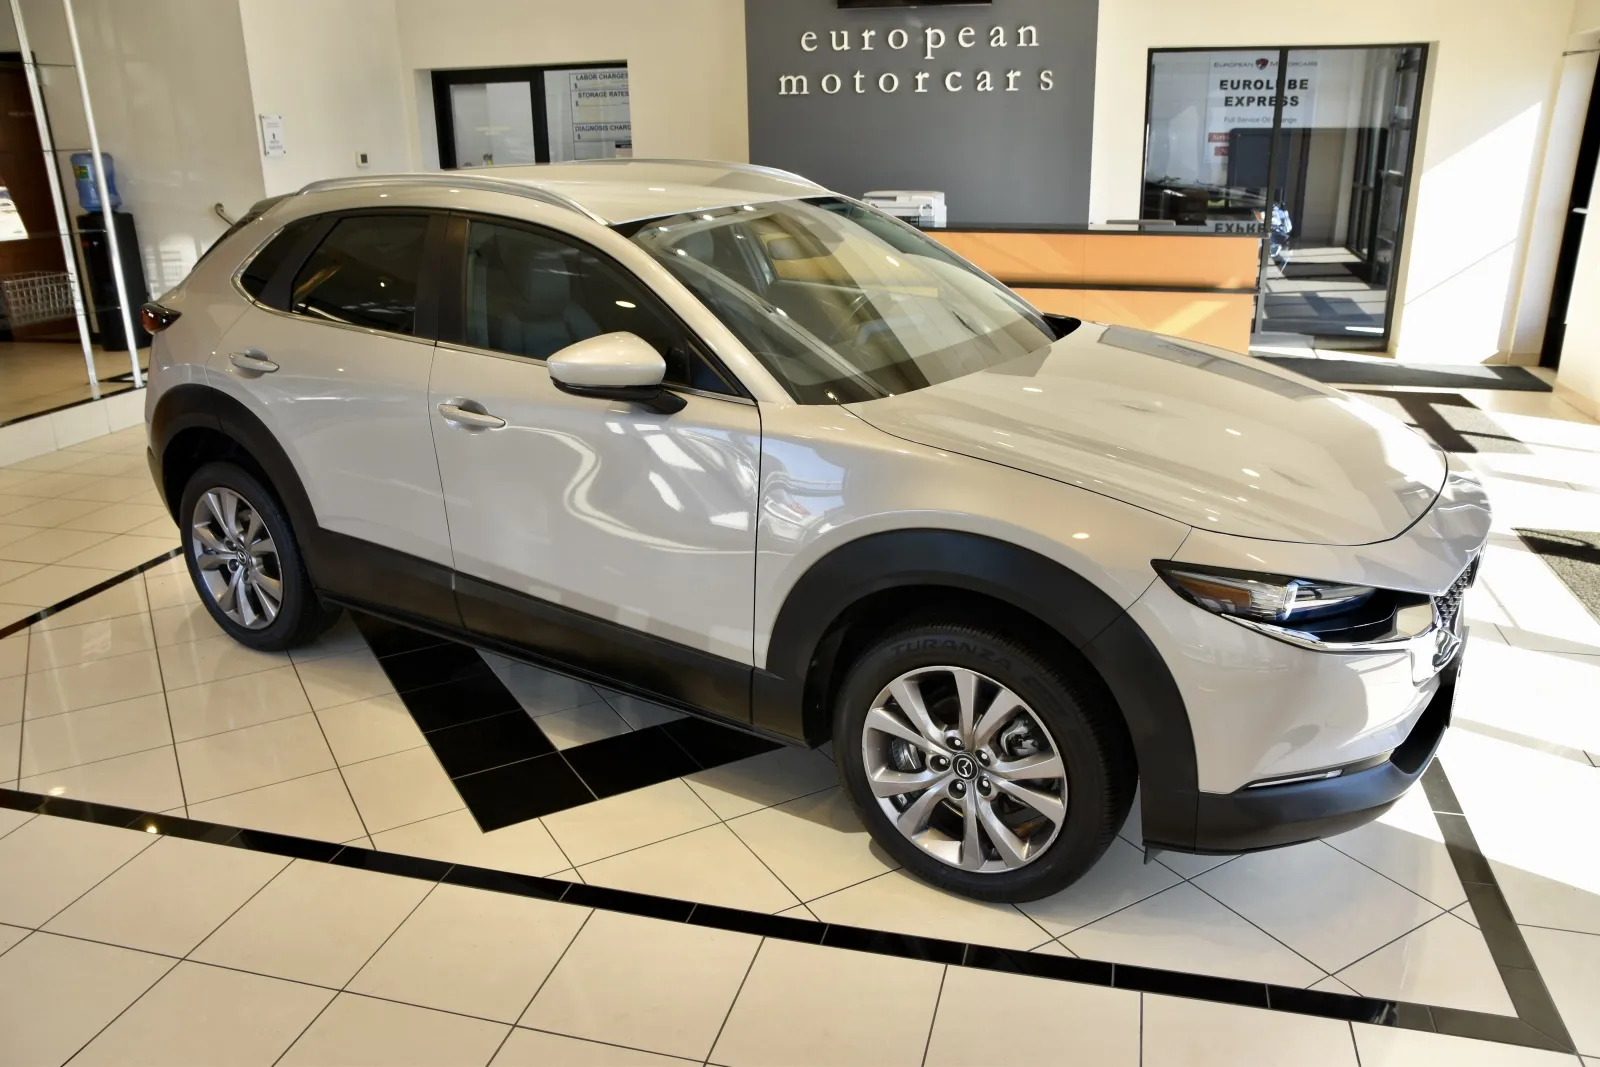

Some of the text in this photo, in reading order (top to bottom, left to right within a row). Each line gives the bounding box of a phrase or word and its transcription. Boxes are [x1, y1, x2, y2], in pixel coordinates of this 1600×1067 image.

[800, 24, 1039, 60] european
[578, 91, 608, 99] STORAGE
[778, 69, 1054, 95] motorcars
[1219, 79, 1309, 90] EUROLBE
[890, 638, 1012, 671] TURANZA
